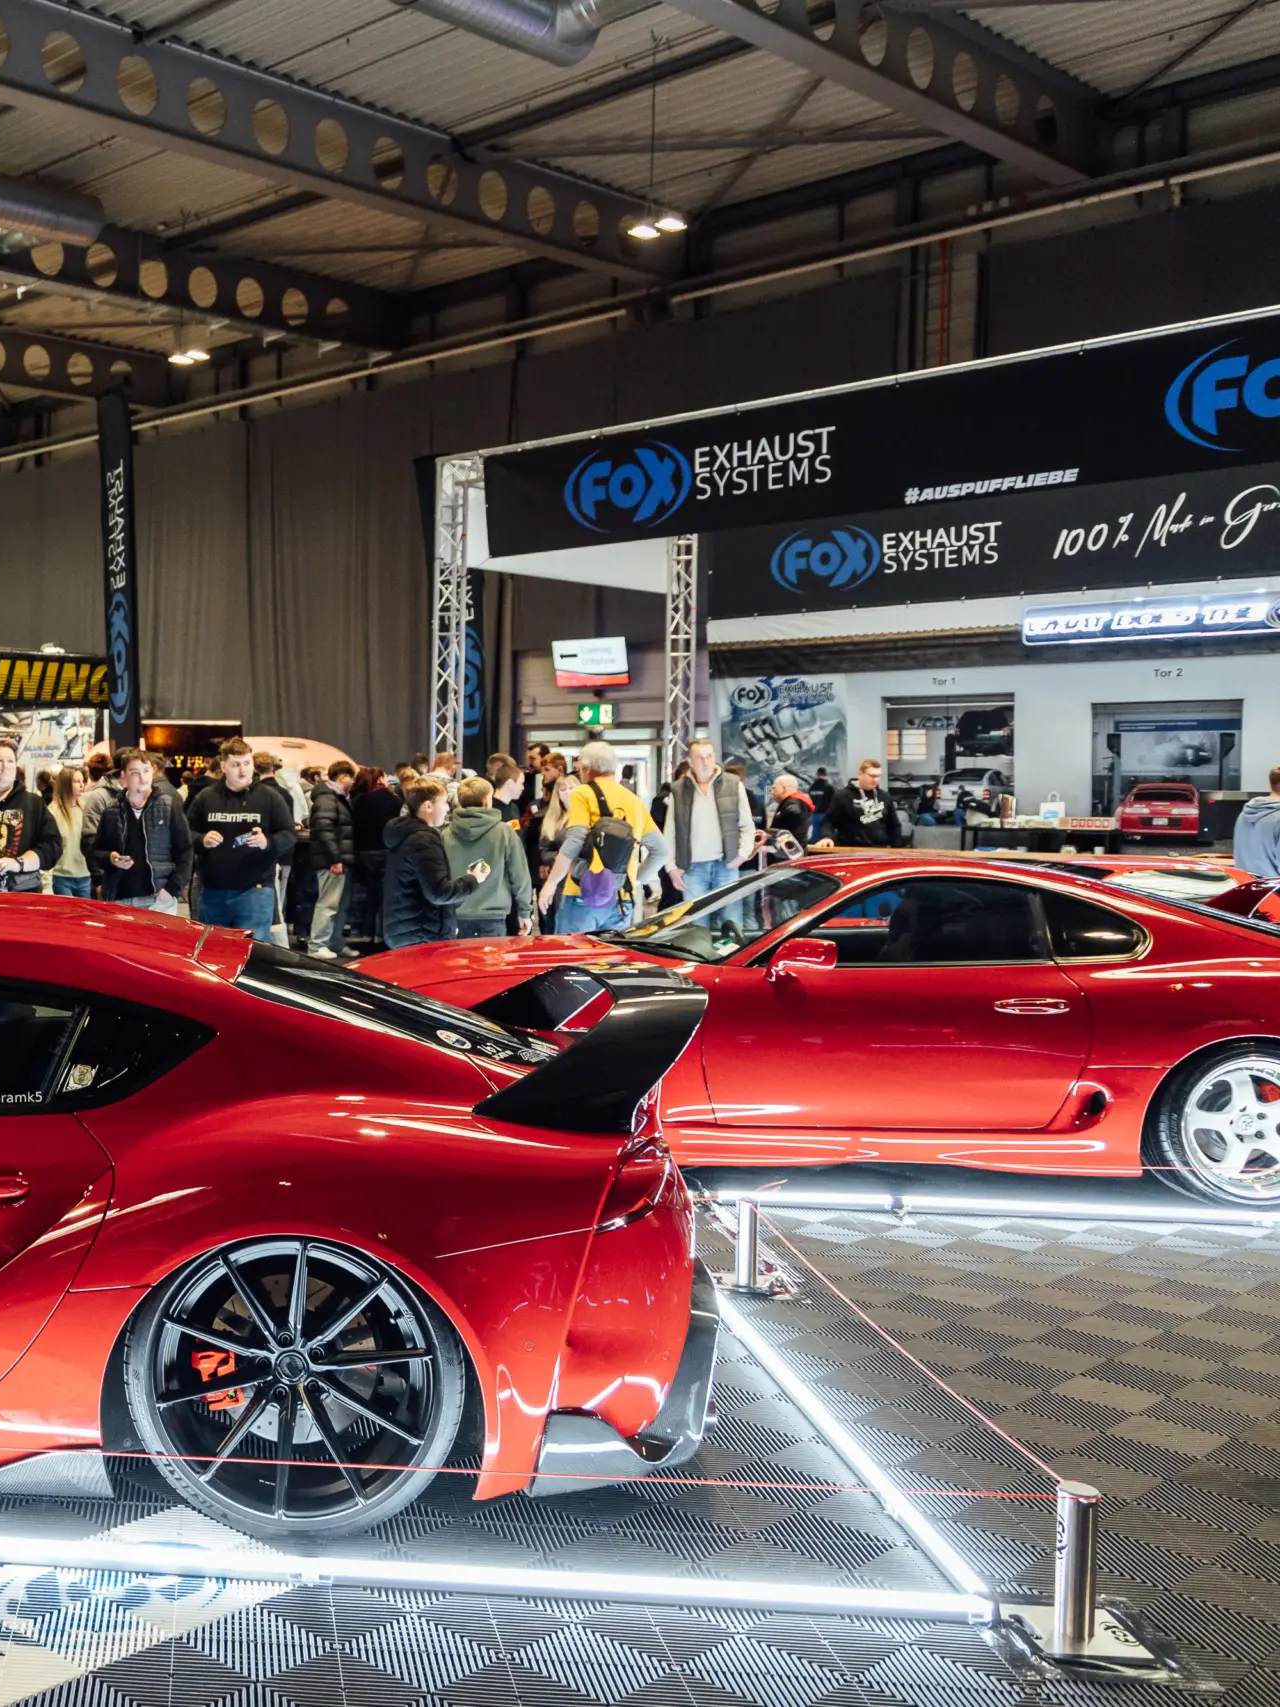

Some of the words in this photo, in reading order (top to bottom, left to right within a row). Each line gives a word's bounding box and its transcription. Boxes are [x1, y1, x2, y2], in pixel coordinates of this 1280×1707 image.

[579, 448, 676, 522] FOX
[694, 426, 836, 474] EXHAUST
[696, 454, 832, 500] SYSTEMS
[904, 468, 1079, 505] #AUSPUFFLIEBE
[1134, 492, 1193, 558] Made
[784, 530, 869, 588] FOX
[882, 521, 1003, 553] EXHAUST
[883, 543, 999, 574] SYSTEMS
[932, 677, 949, 686] Tor
[951, 677, 956, 686] 1
[1154, 668, 1173, 678] Tor
[1176, 667, 1183, 677] 2
[737, 684, 766, 704] FOX
[779, 682, 834, 694] EXHAUST
